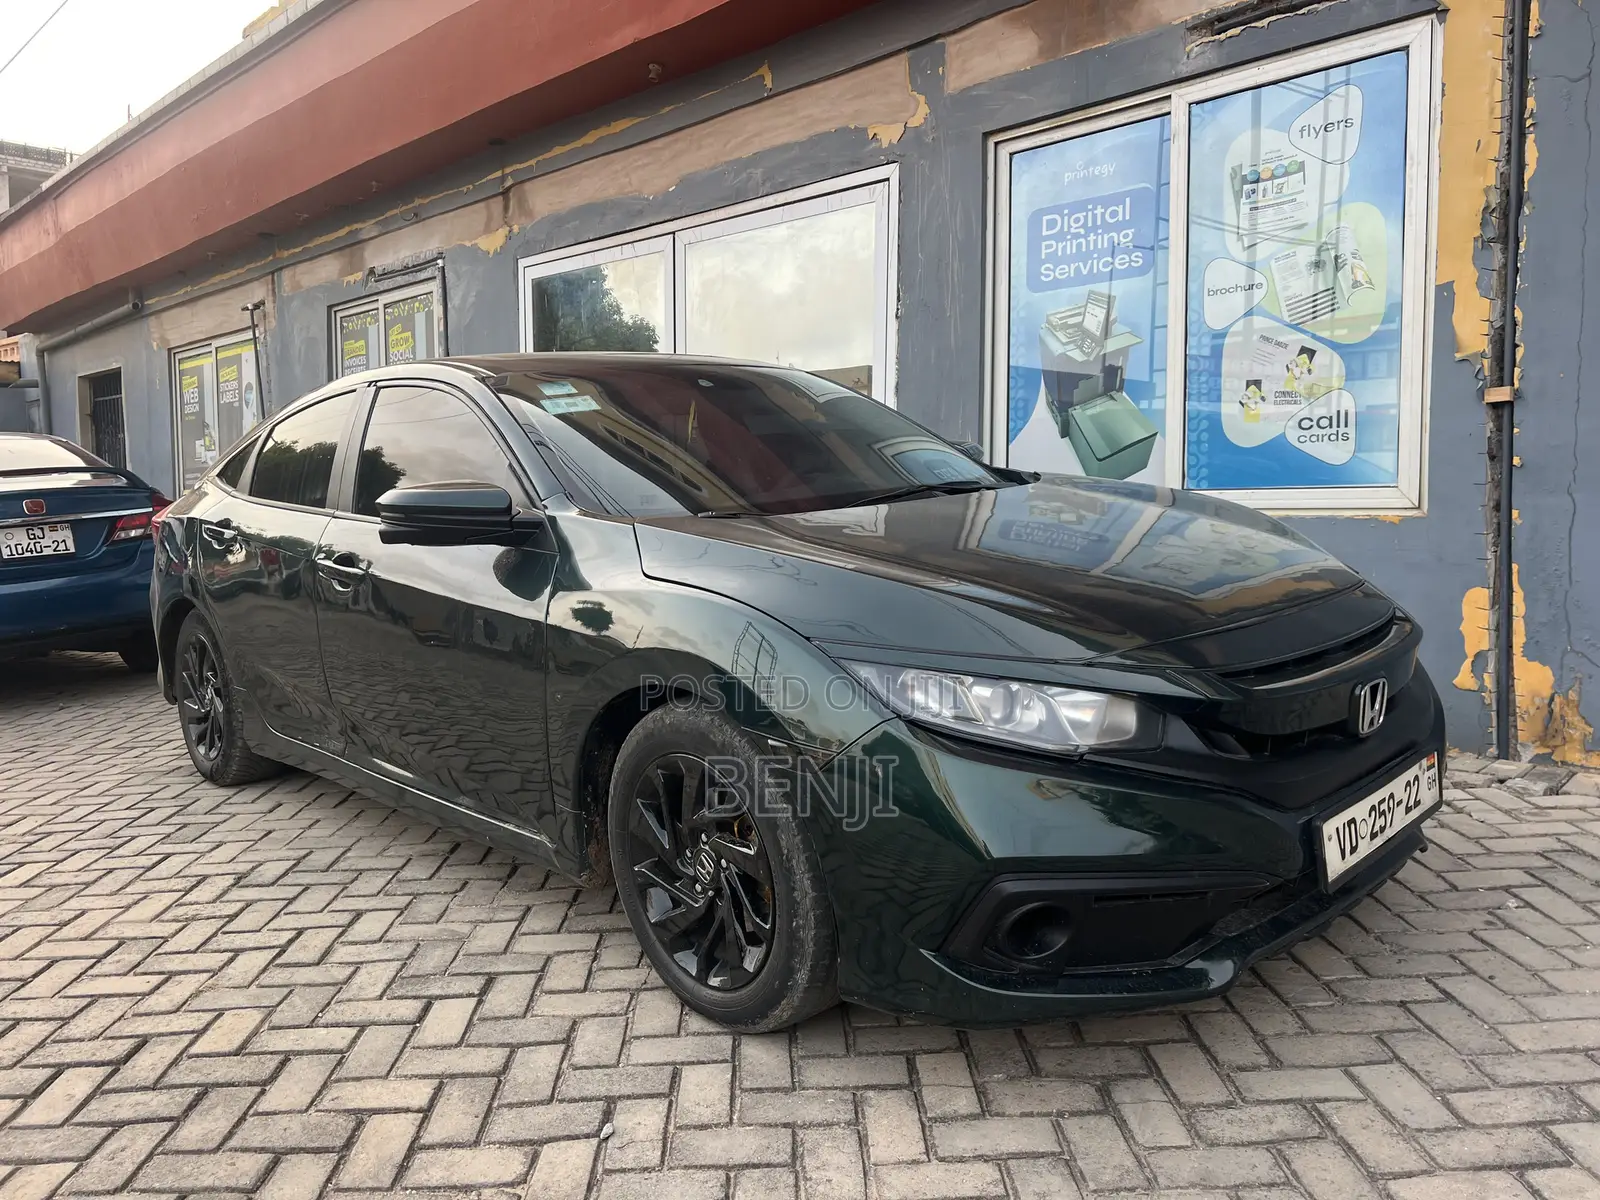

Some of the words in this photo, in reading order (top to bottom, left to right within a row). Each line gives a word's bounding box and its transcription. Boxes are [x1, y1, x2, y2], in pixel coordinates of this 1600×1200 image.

[1299, 117, 1354, 139] flyers
[1064, 161, 1116, 186] printegy
[1041, 197, 1131, 236] Digital
[1041, 228, 1135, 259] Printing
[1040, 251, 1143, 282] Services
[1207, 281, 1264, 297] brochure
[390, 335, 411, 349] GROW
[390, 347, 414, 362] SOCIAL
[183, 388, 199, 404] WEB
[220, 389, 239, 404] LABELS
[1297, 409, 1349, 431] call
[1297, 430, 1350, 444] cards
[26, 527, 45, 540] GJ
[5, 539, 70, 556] 1040-21
[1335, 817, 1360, 861] VD
[1368, 774, 1421, 842] 259-22
[1427, 773, 1438, 791] GH
